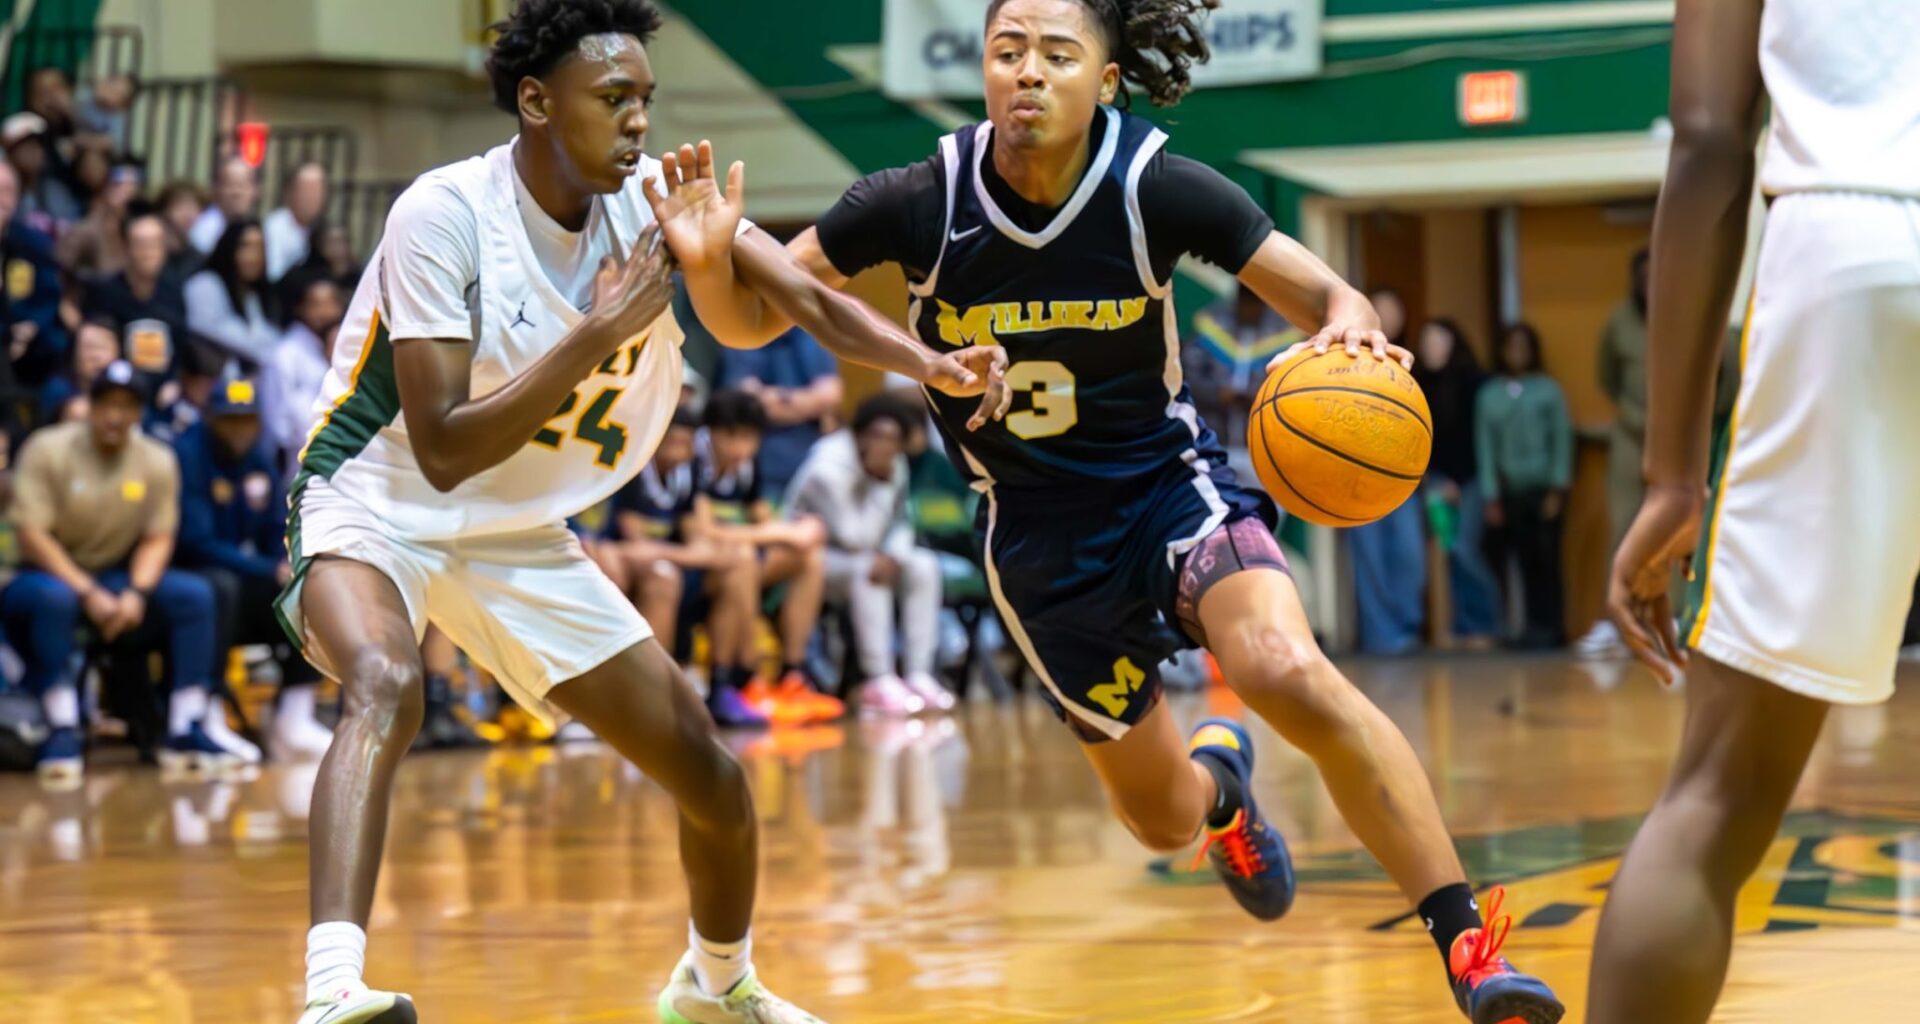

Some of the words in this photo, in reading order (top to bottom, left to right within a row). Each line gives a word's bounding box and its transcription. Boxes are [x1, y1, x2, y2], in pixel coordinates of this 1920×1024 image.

[935, 296, 1148, 347] MILLIKAN
[1004, 360, 1079, 441] 3
[1086, 655, 1146, 719] M
